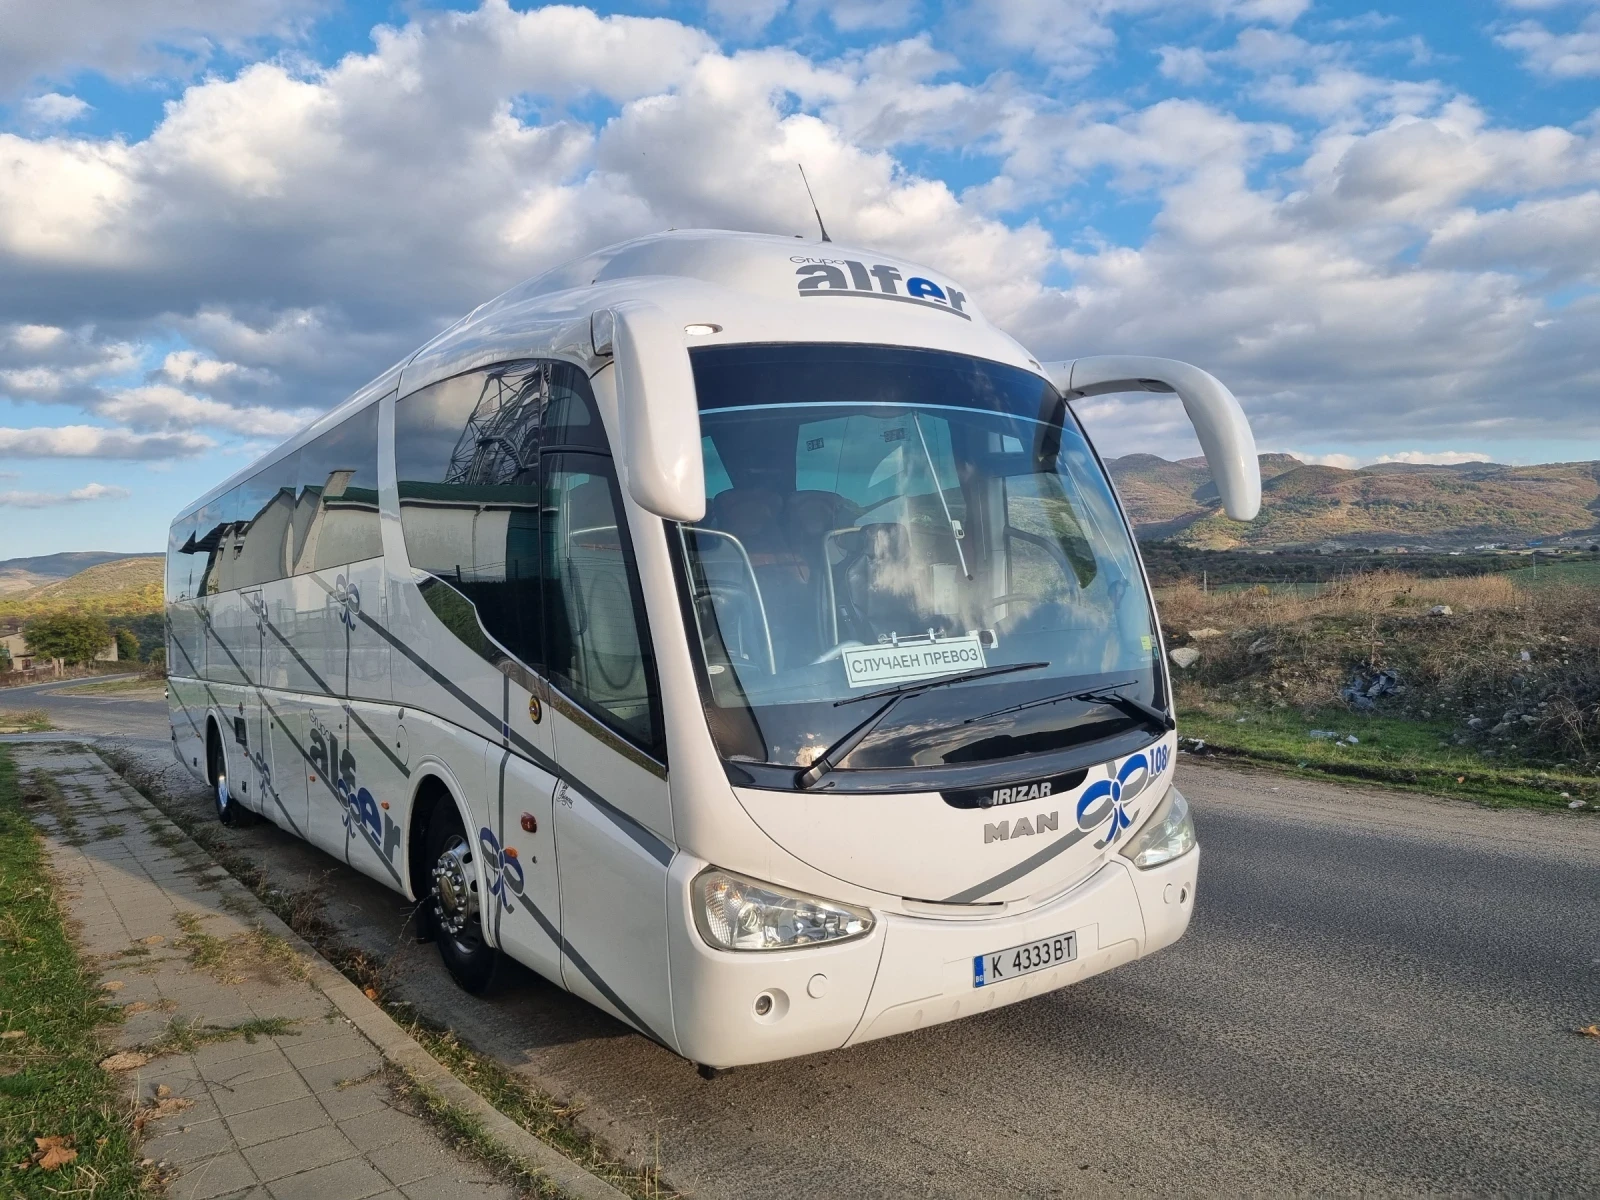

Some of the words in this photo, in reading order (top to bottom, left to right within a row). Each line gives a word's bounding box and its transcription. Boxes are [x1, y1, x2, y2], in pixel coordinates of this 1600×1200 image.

[790, 256, 846, 265] Grupo
[796, 260, 967, 312] alfer
[852, 653, 920, 673] СЛУЧАЕН
[924, 648, 978, 666] ПРЕВОЗ
[1150, 744, 1167, 775] 108
[310, 728, 401, 864] alfer
[992, 782, 1052, 805] IRIZAR
[984, 811, 1059, 844] MAN
